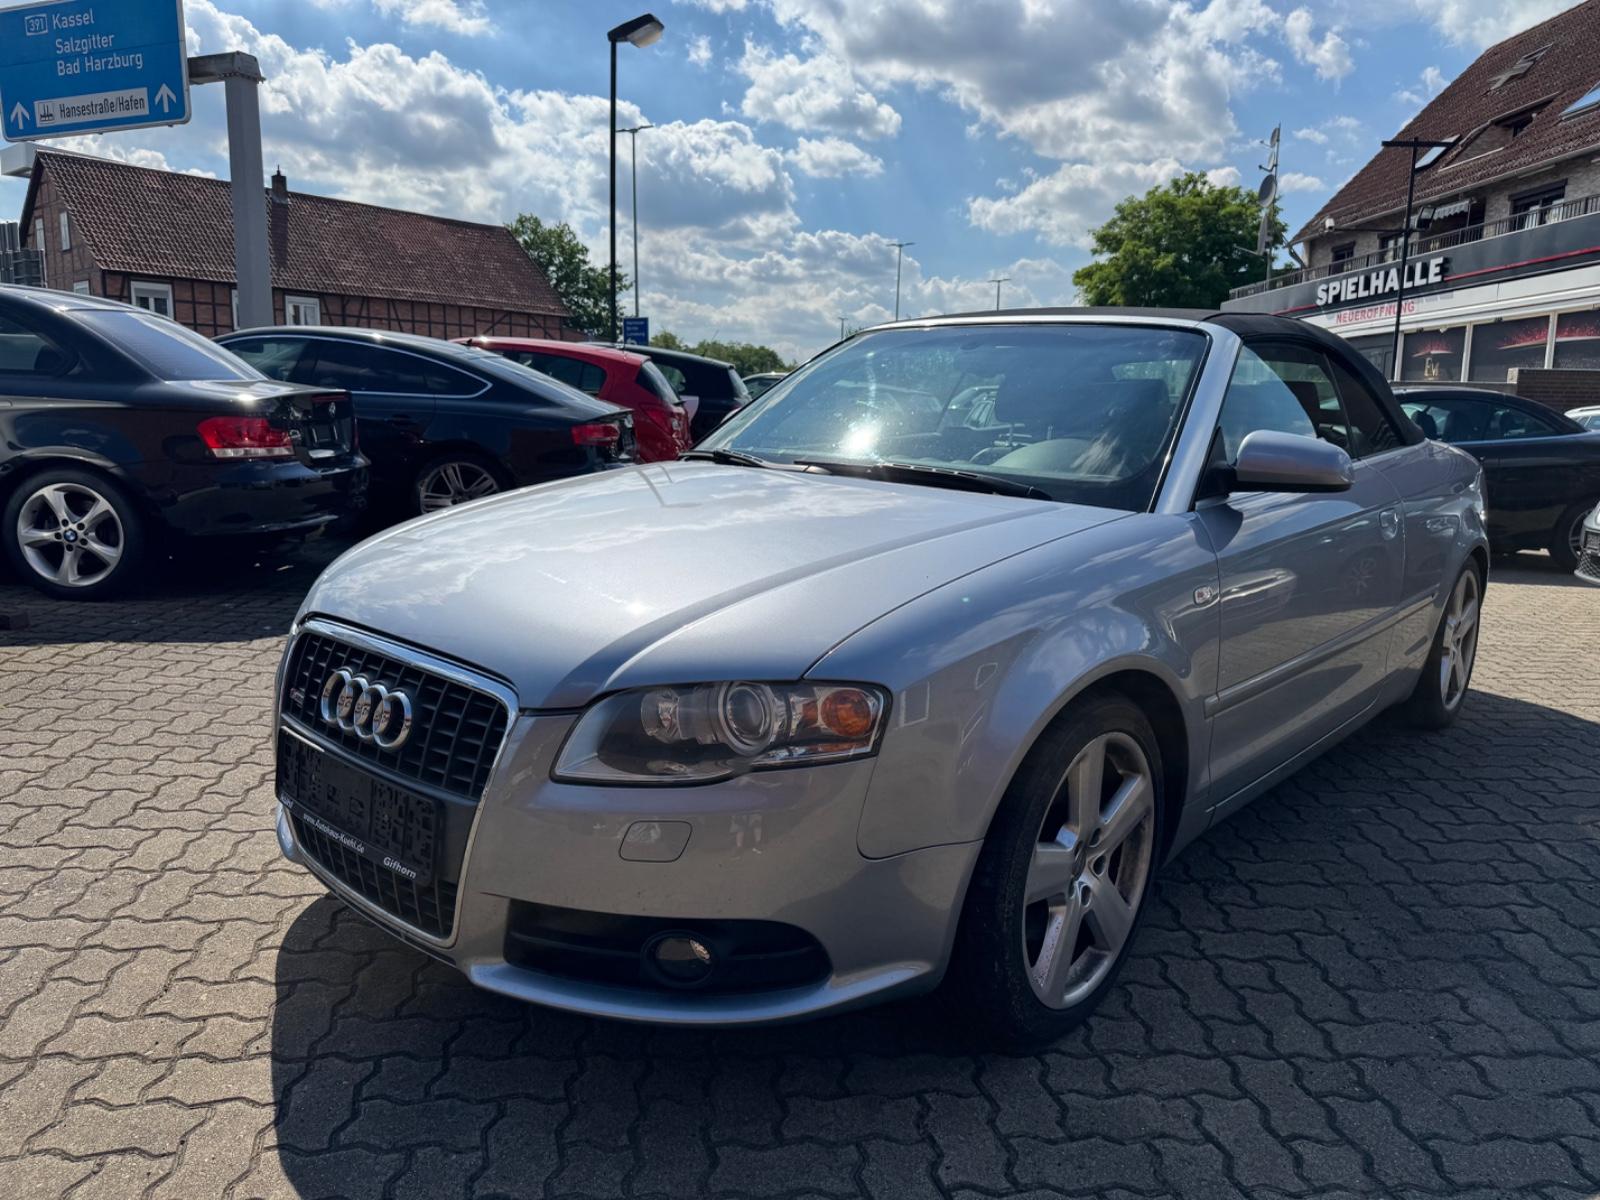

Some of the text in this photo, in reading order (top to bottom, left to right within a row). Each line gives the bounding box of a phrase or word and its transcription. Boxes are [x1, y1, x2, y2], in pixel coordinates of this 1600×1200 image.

[29, 8, 95, 32] 391 Kassel
[55, 34, 115, 54] Salzgitter
[57, 52, 143, 76] Bad Harzburg
[1316, 256, 1445, 306] SPIELHALLE
[383, 856, 417, 879] Gifhorn
